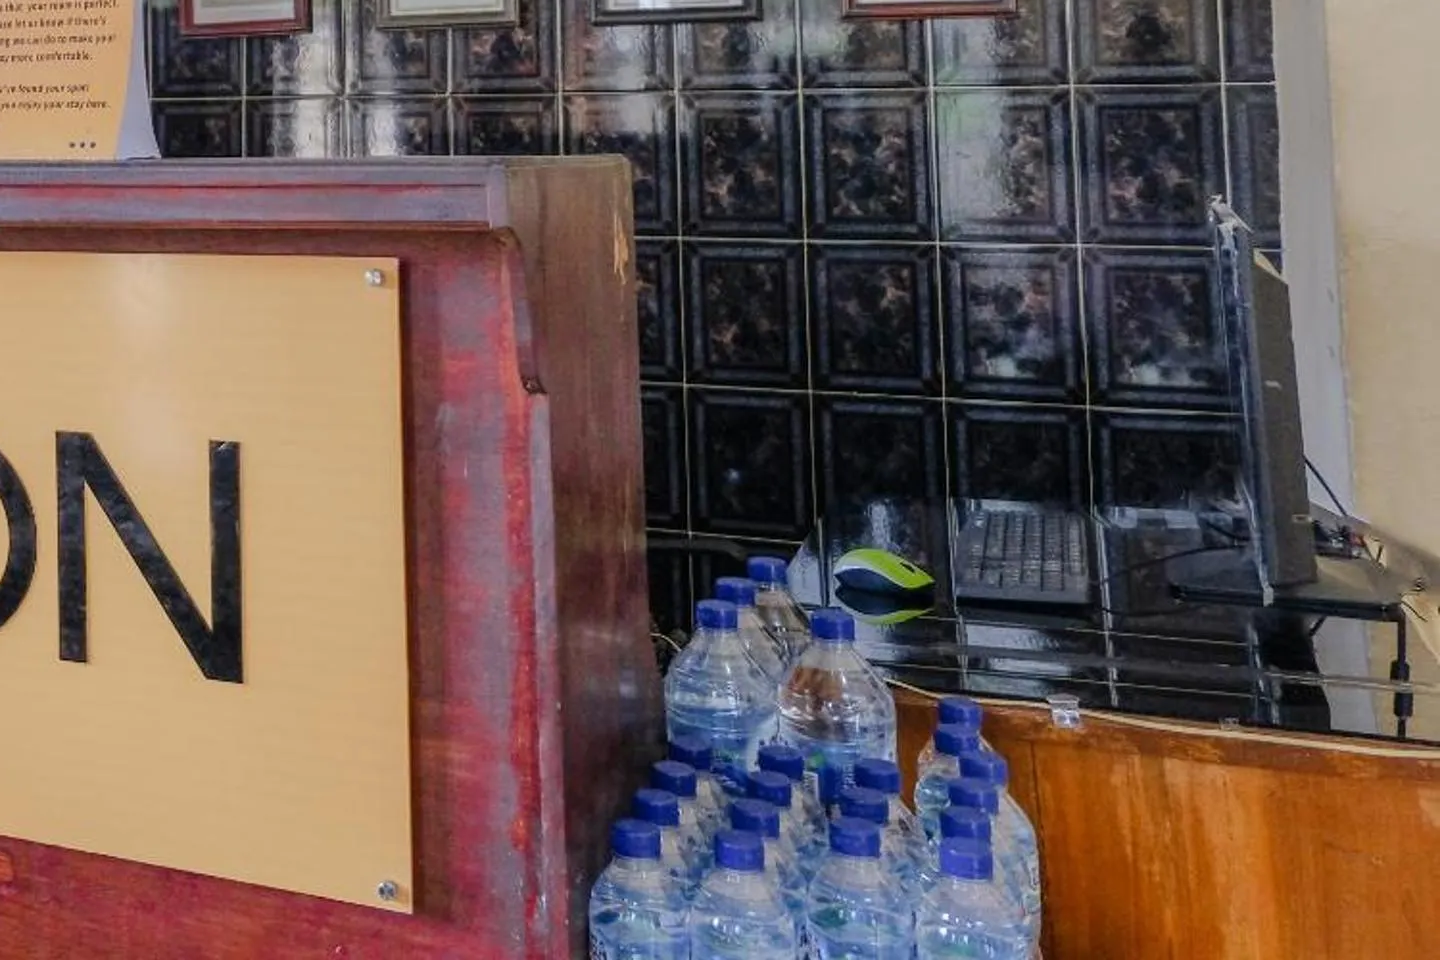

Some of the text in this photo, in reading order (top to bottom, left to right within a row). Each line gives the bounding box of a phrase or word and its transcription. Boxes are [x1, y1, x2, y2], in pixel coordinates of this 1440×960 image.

[5, 2, 23, 13] that
[27, 2, 47, 13] your
[49, 1, 72, 10] room
[39, 17, 64, 28] know
[69, 34, 94, 44] make
[11, 54, 33, 63] more
[66, 99, 85, 112] stay
